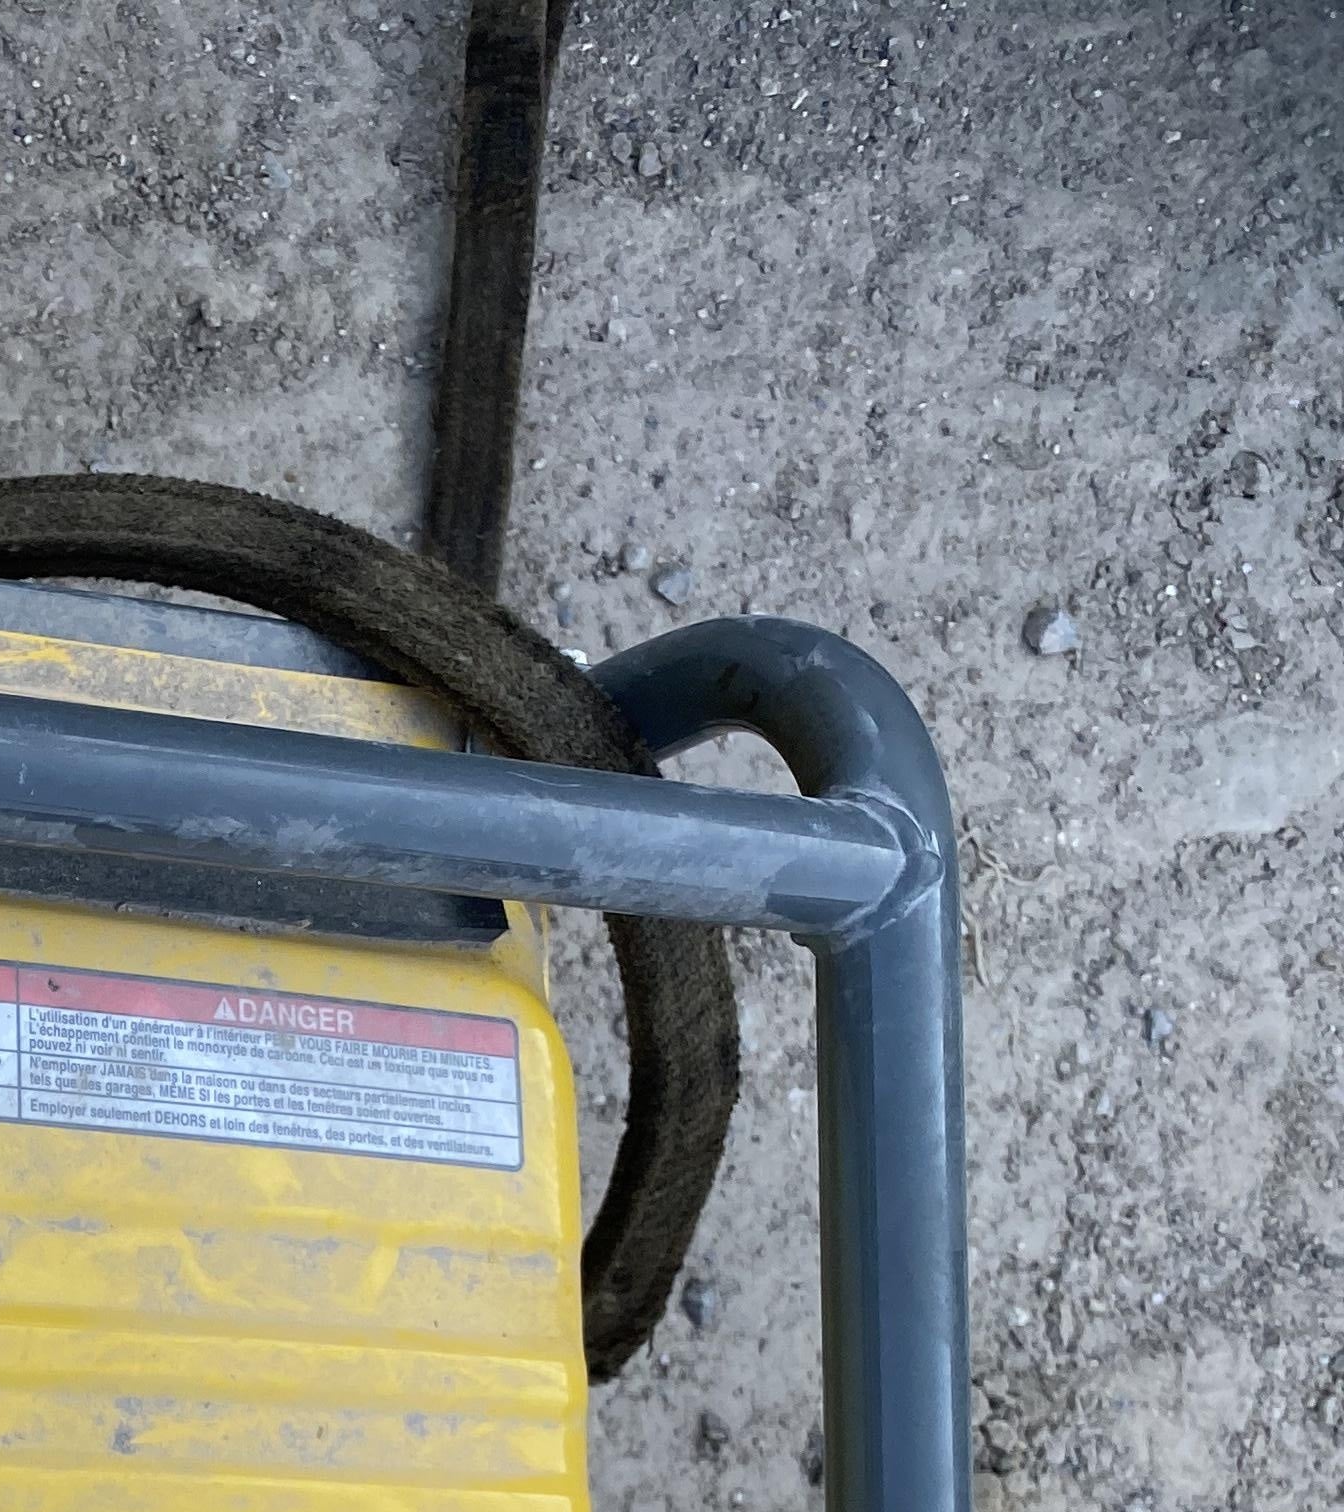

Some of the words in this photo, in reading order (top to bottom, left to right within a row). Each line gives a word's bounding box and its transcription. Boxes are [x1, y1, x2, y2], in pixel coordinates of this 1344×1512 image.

[238, 999, 355, 1034] DANGER
[208, 1116, 221, 1130] et
[389, 1134, 401, 1147] et
